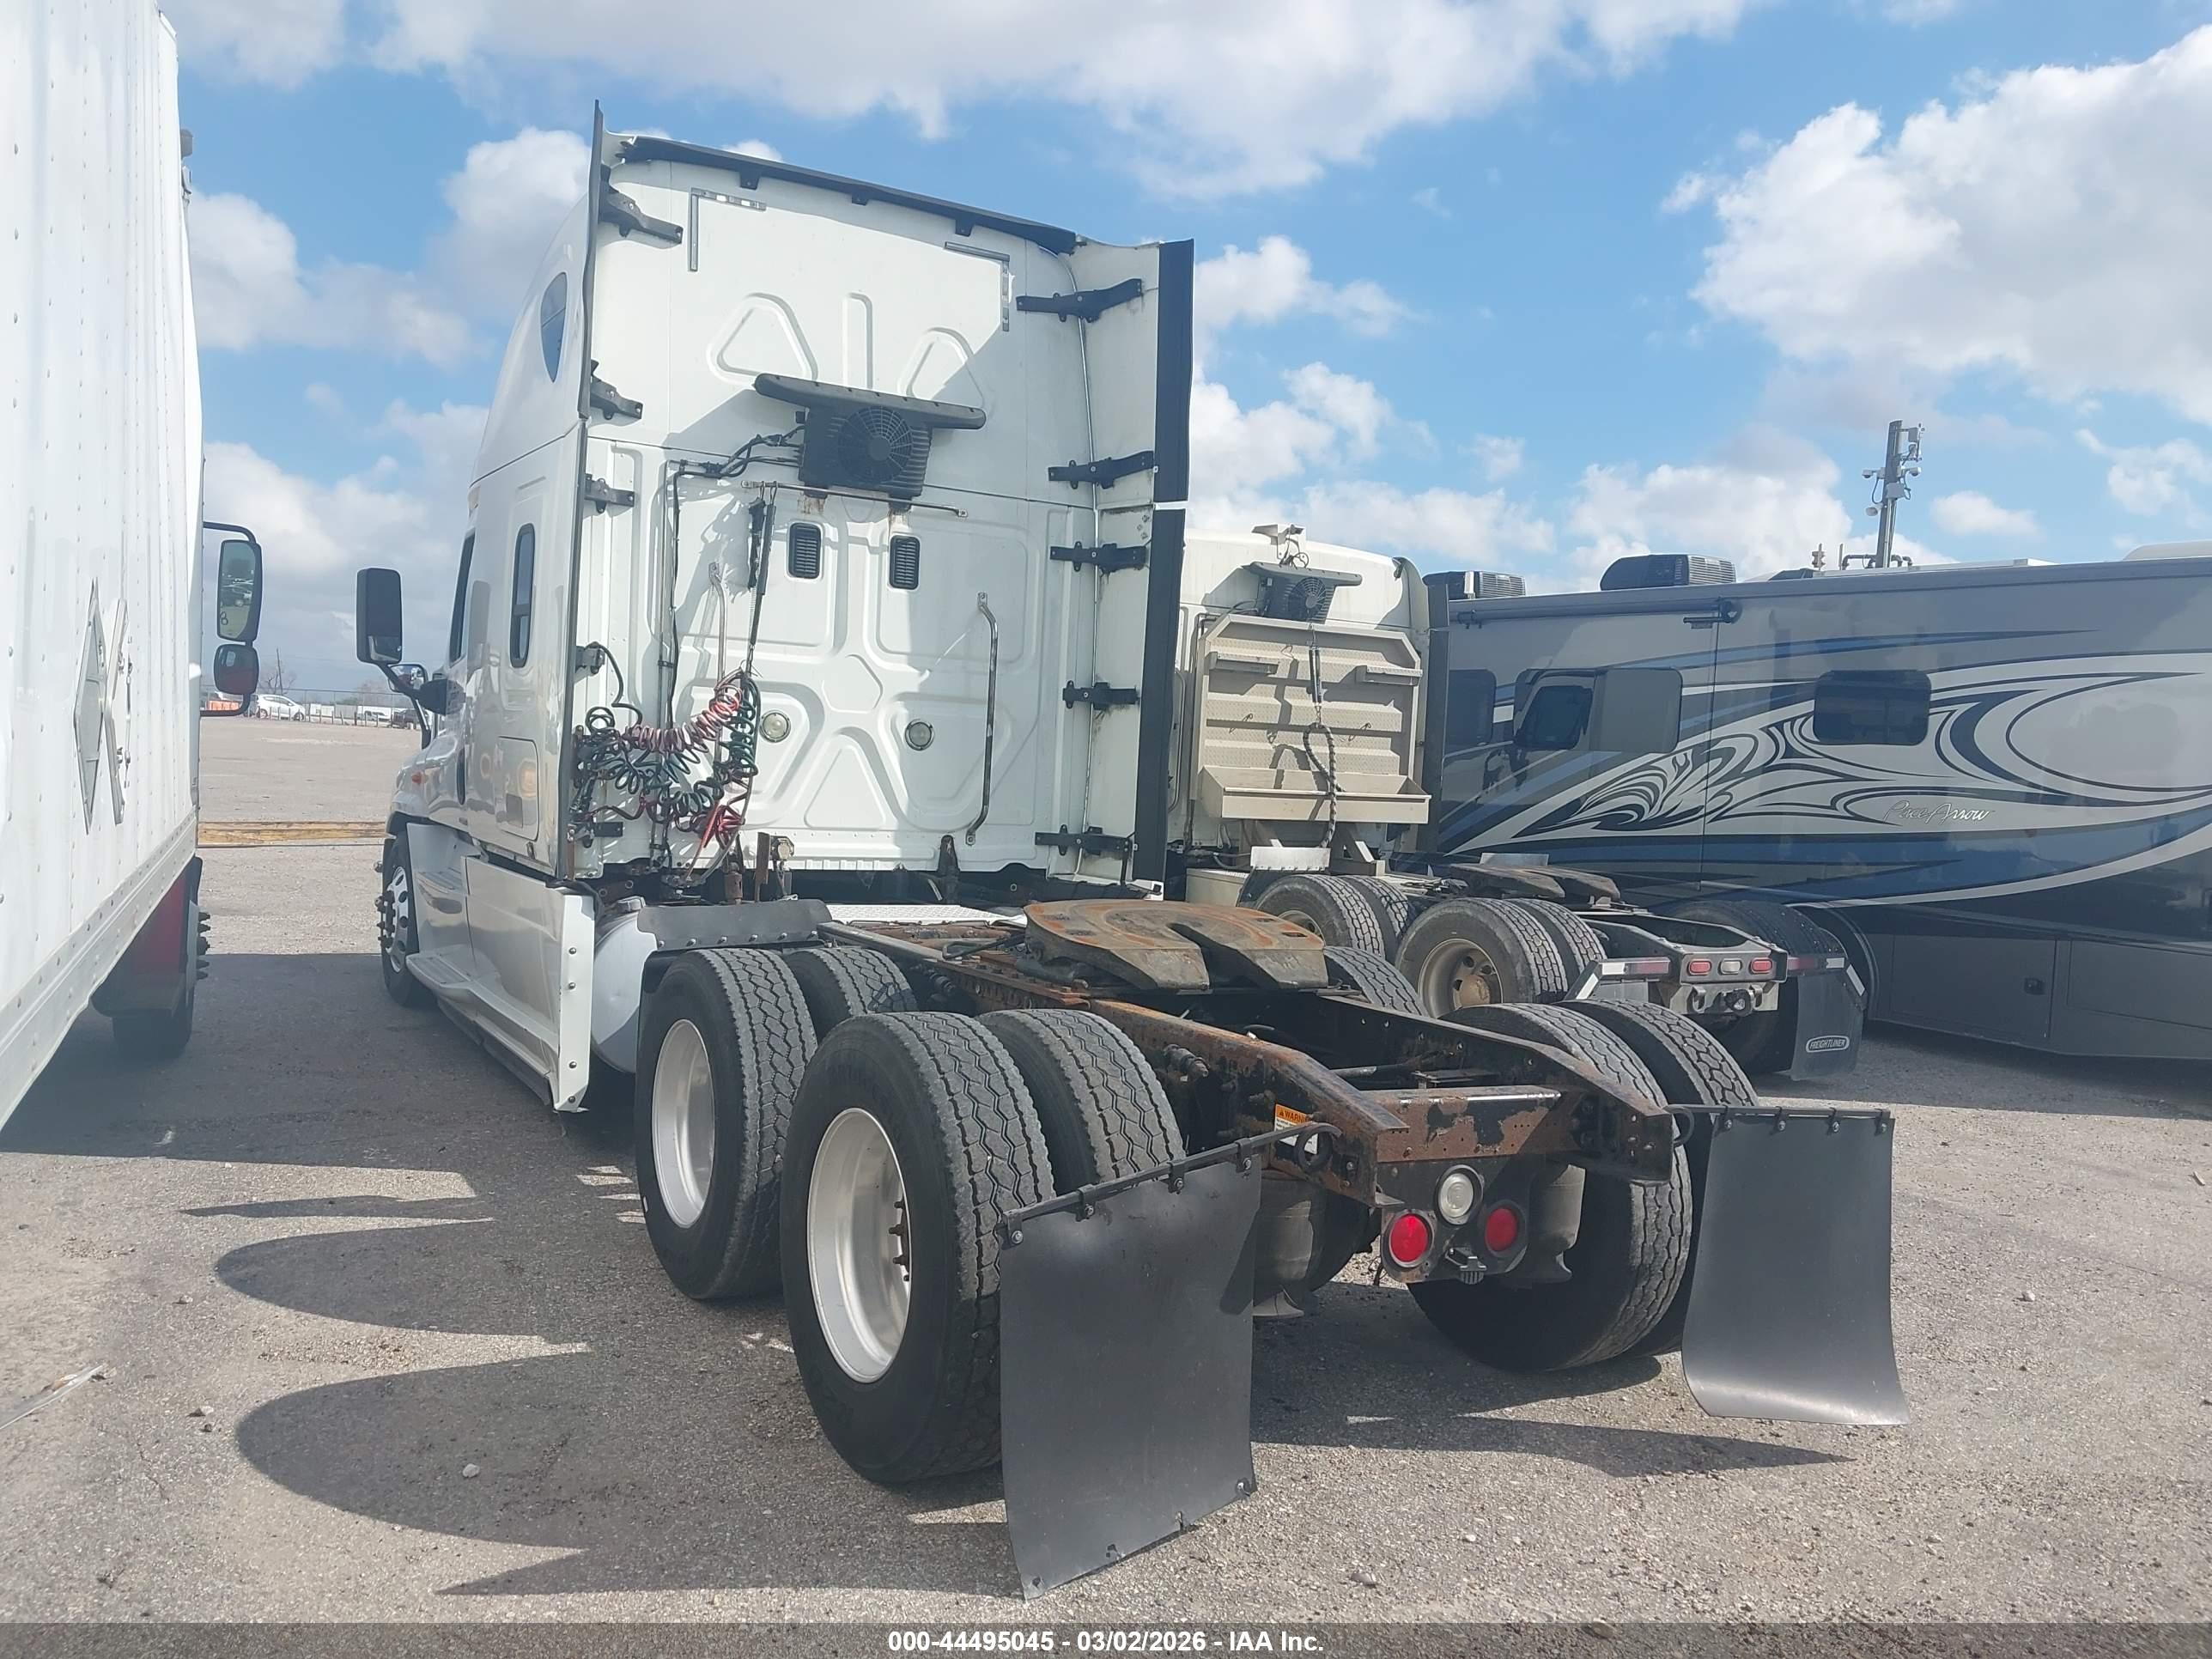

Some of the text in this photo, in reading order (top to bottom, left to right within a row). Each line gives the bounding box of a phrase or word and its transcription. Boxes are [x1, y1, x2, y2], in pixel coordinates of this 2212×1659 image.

[1882, 799, 1990, 824] Pace Arrow
[1809, 1038, 1846, 1050] FREIGHTLINER
